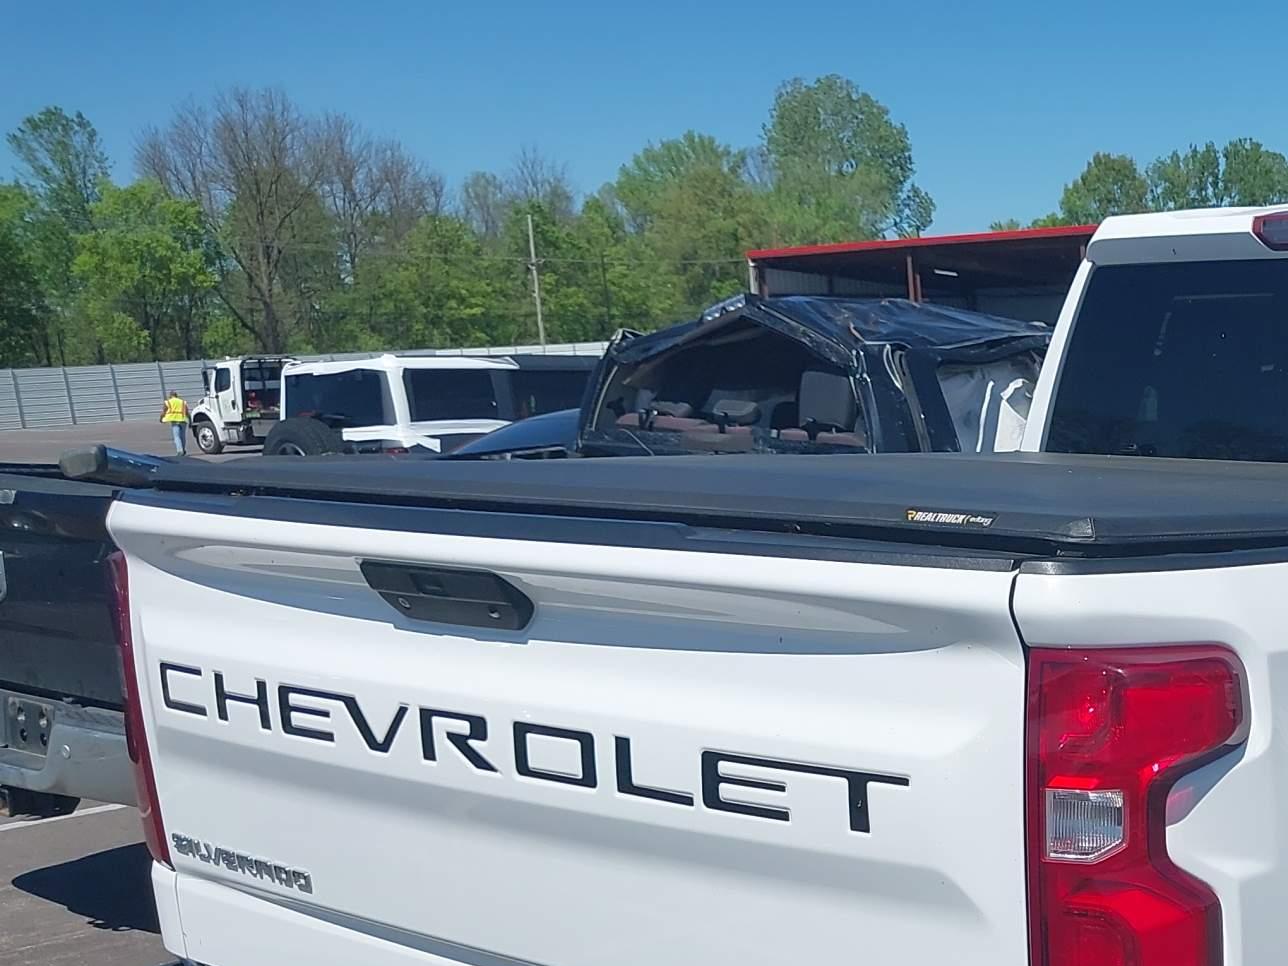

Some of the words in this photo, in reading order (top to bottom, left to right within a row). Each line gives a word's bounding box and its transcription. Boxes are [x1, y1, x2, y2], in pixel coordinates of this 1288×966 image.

[914, 511, 966, 524] REALTRUCK
[160, 661, 910, 834] CHEVROLET
[171, 831, 313, 894] SILVERADO
